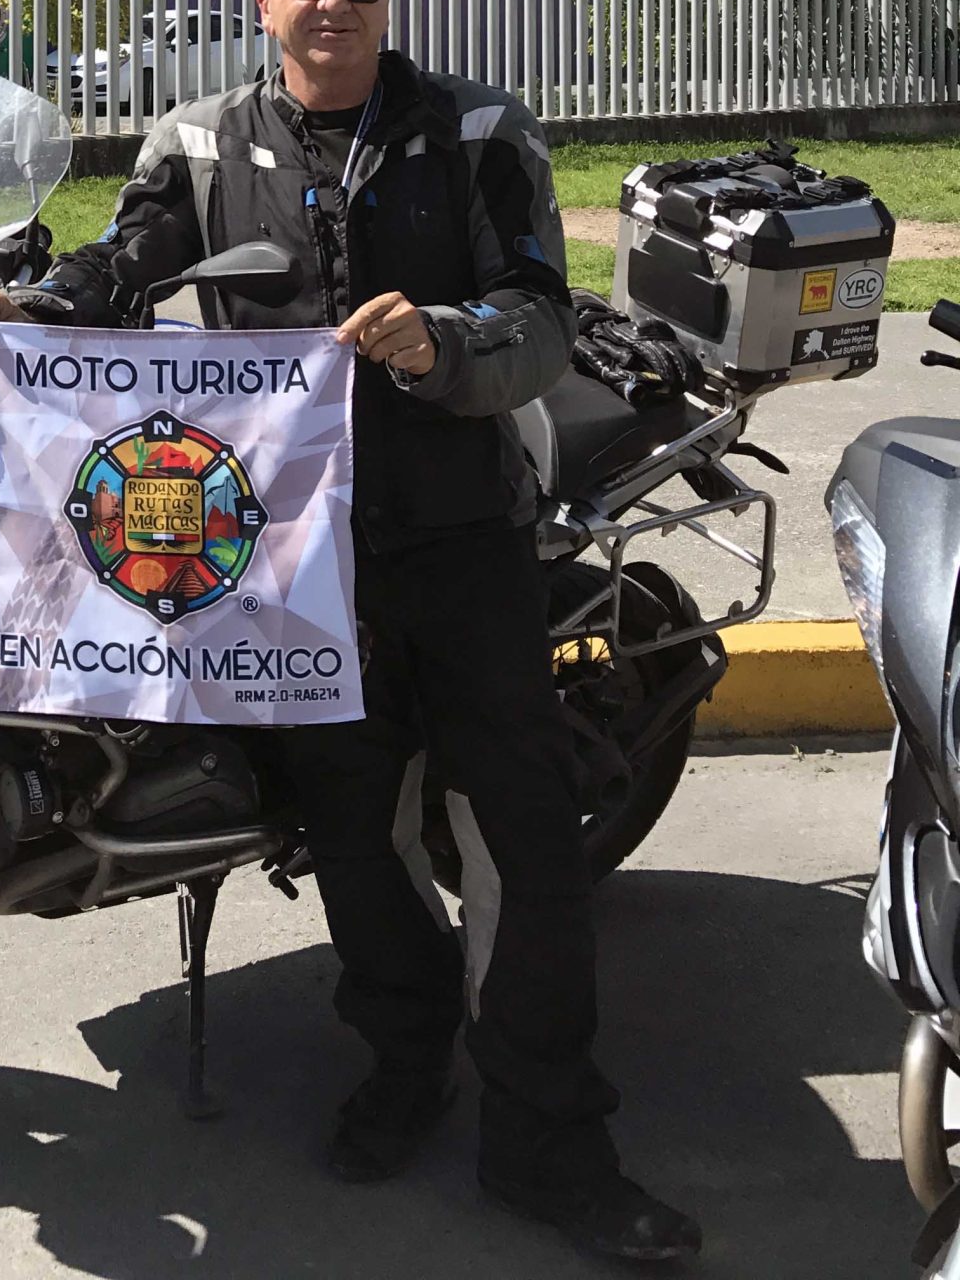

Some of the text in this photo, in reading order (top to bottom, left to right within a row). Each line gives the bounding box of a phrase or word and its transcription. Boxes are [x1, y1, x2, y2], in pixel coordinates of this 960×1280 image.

[845, 277, 876, 296] YRC
[860, 324, 870, 332] the
[833, 335, 875, 346] Dalton Highway
[15, 352, 310, 395] MOTO TURISTA
[153, 420, 173, 435] N
[69, 503, 88, 518] O
[242, 509, 260, 526] E
[157, 598, 176, 615] S
[0, 633, 343, 681] EN ACCIÓN MÉXICO
[234, 687, 341, 703] RRM 2.0-RA6214
